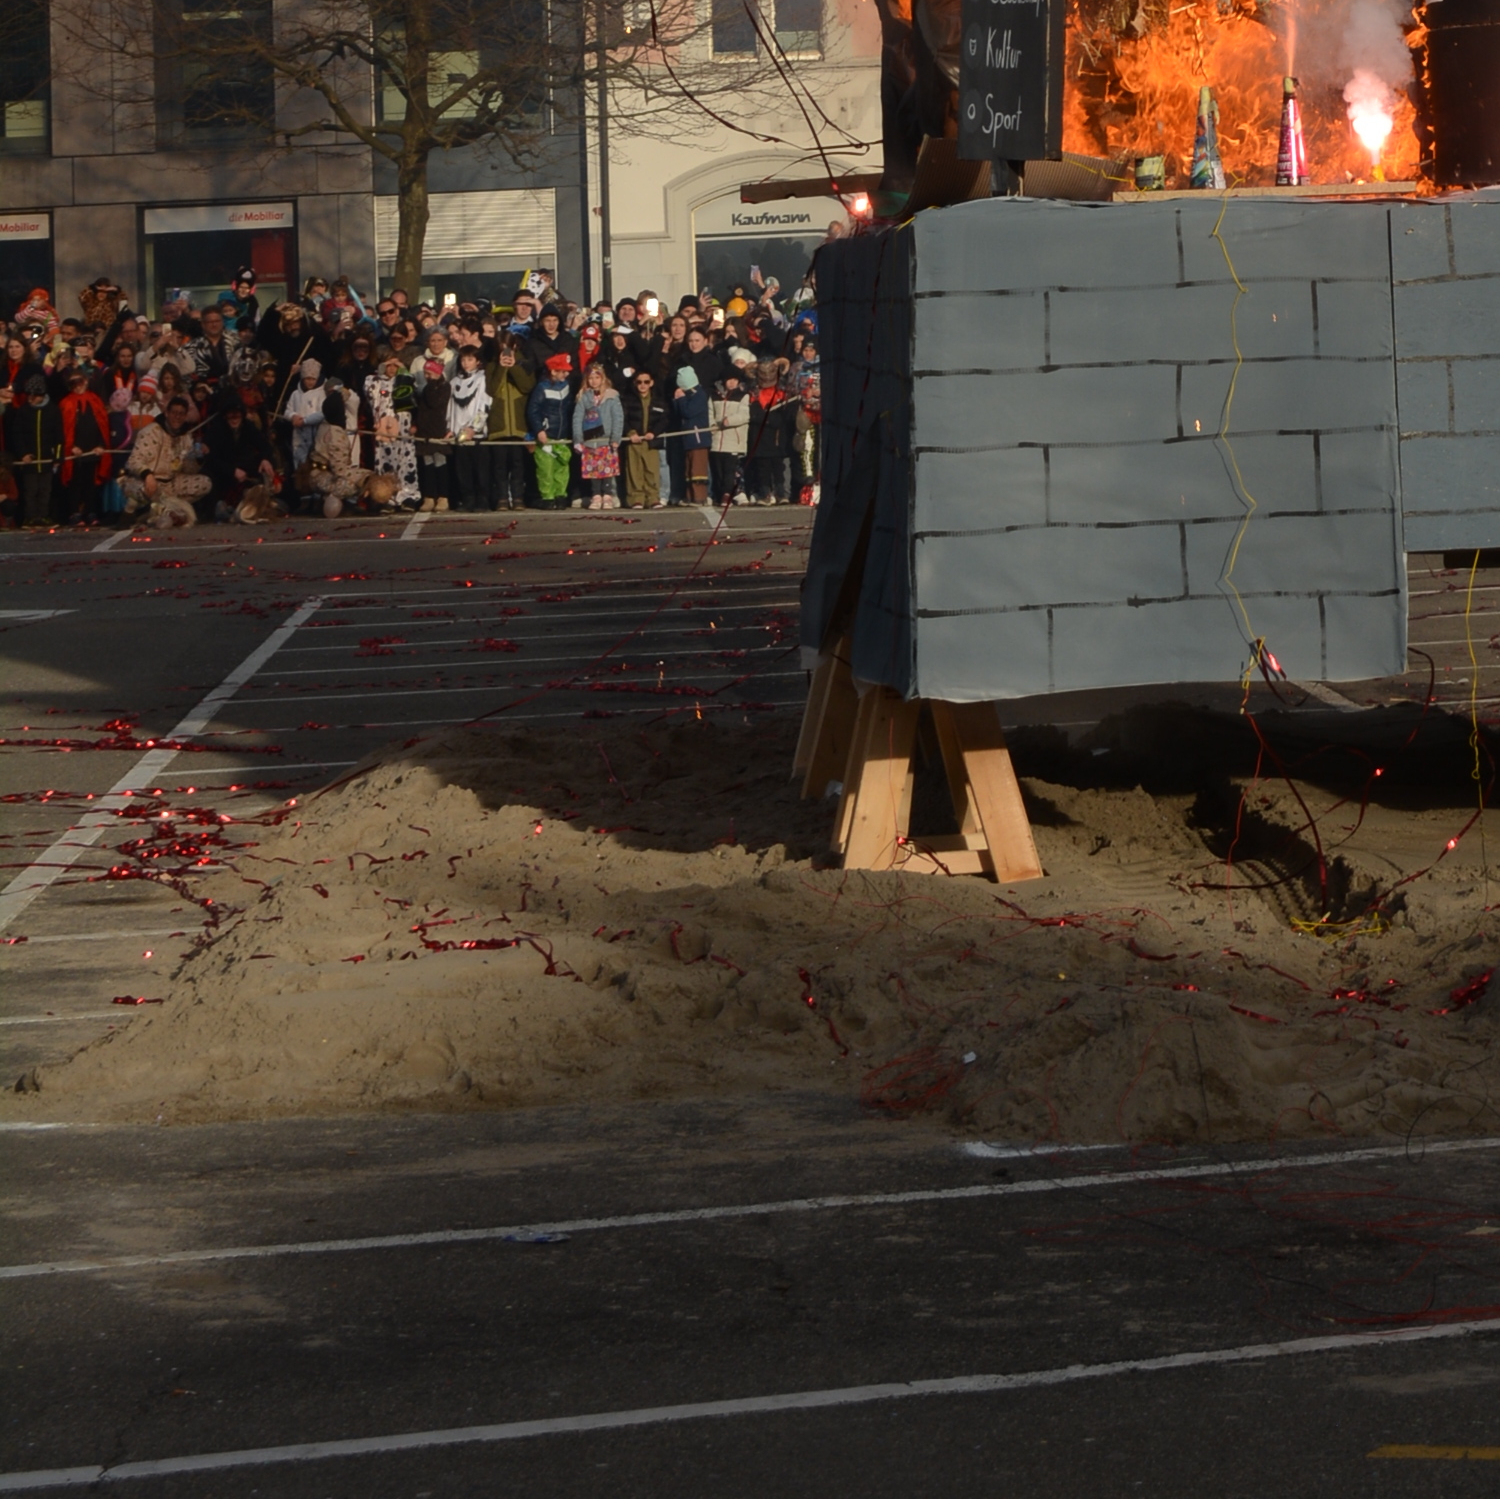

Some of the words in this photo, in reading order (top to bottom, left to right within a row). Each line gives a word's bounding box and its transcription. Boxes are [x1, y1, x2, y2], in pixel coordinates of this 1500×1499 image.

[985, 26, 1022, 69] Kultur
[982, 93, 1022, 148] Sport
[228, 213, 243, 223] die
[244, 210, 285, 222] Mobiliar
[731, 212, 811, 226] Kaufmann
